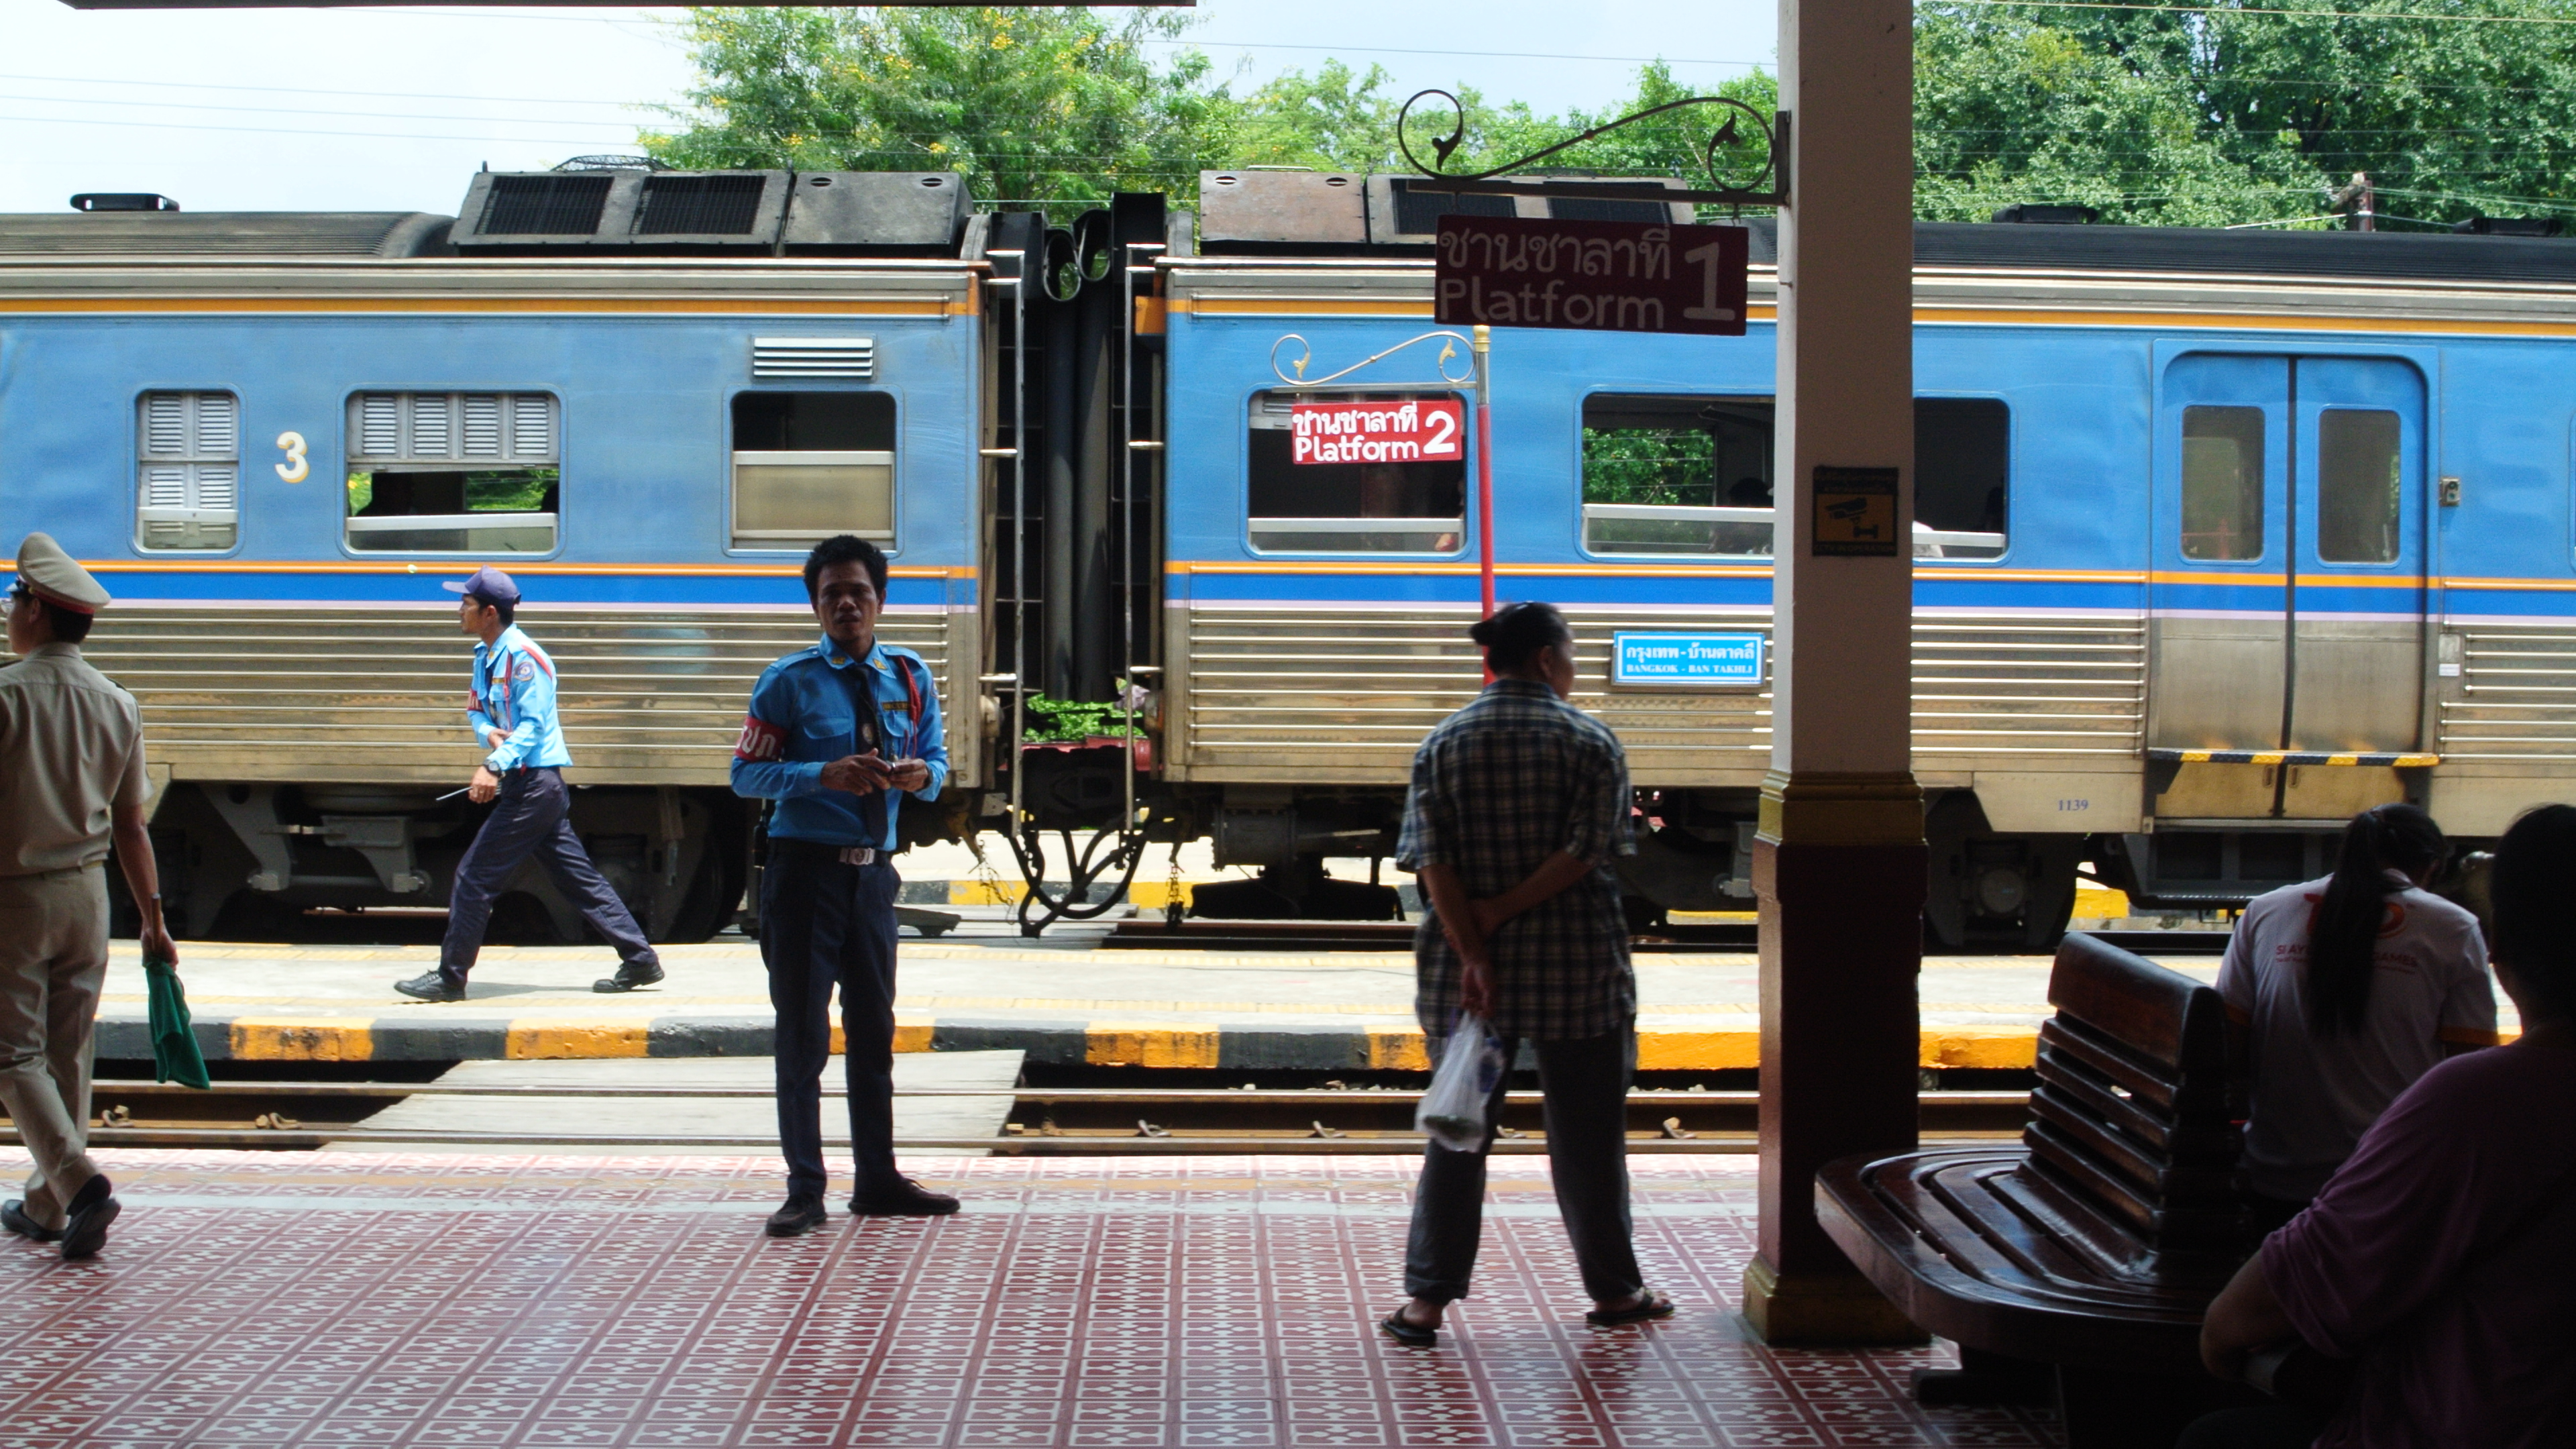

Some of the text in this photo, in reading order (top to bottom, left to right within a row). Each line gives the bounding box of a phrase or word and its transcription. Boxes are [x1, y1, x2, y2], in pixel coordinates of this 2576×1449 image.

[1439, 223, 1670, 280] ชานชาลาที่
[1440, 276, 1664, 329] Platform
[1683, 241, 1735, 322] 1
[1293, 402, 1417, 436] ชานชาลาที่
[1423, 410, 1456, 454] 2
[275, 430, 310, 484] 3
[1295, 435, 1419, 462] Platform
[1626, 664, 1678, 673] BANGKOK
[1688, 665, 1710, 674] BAN
[1713, 665, 1753, 674] TAKHLI
[2058, 799, 2089, 811] 1139
